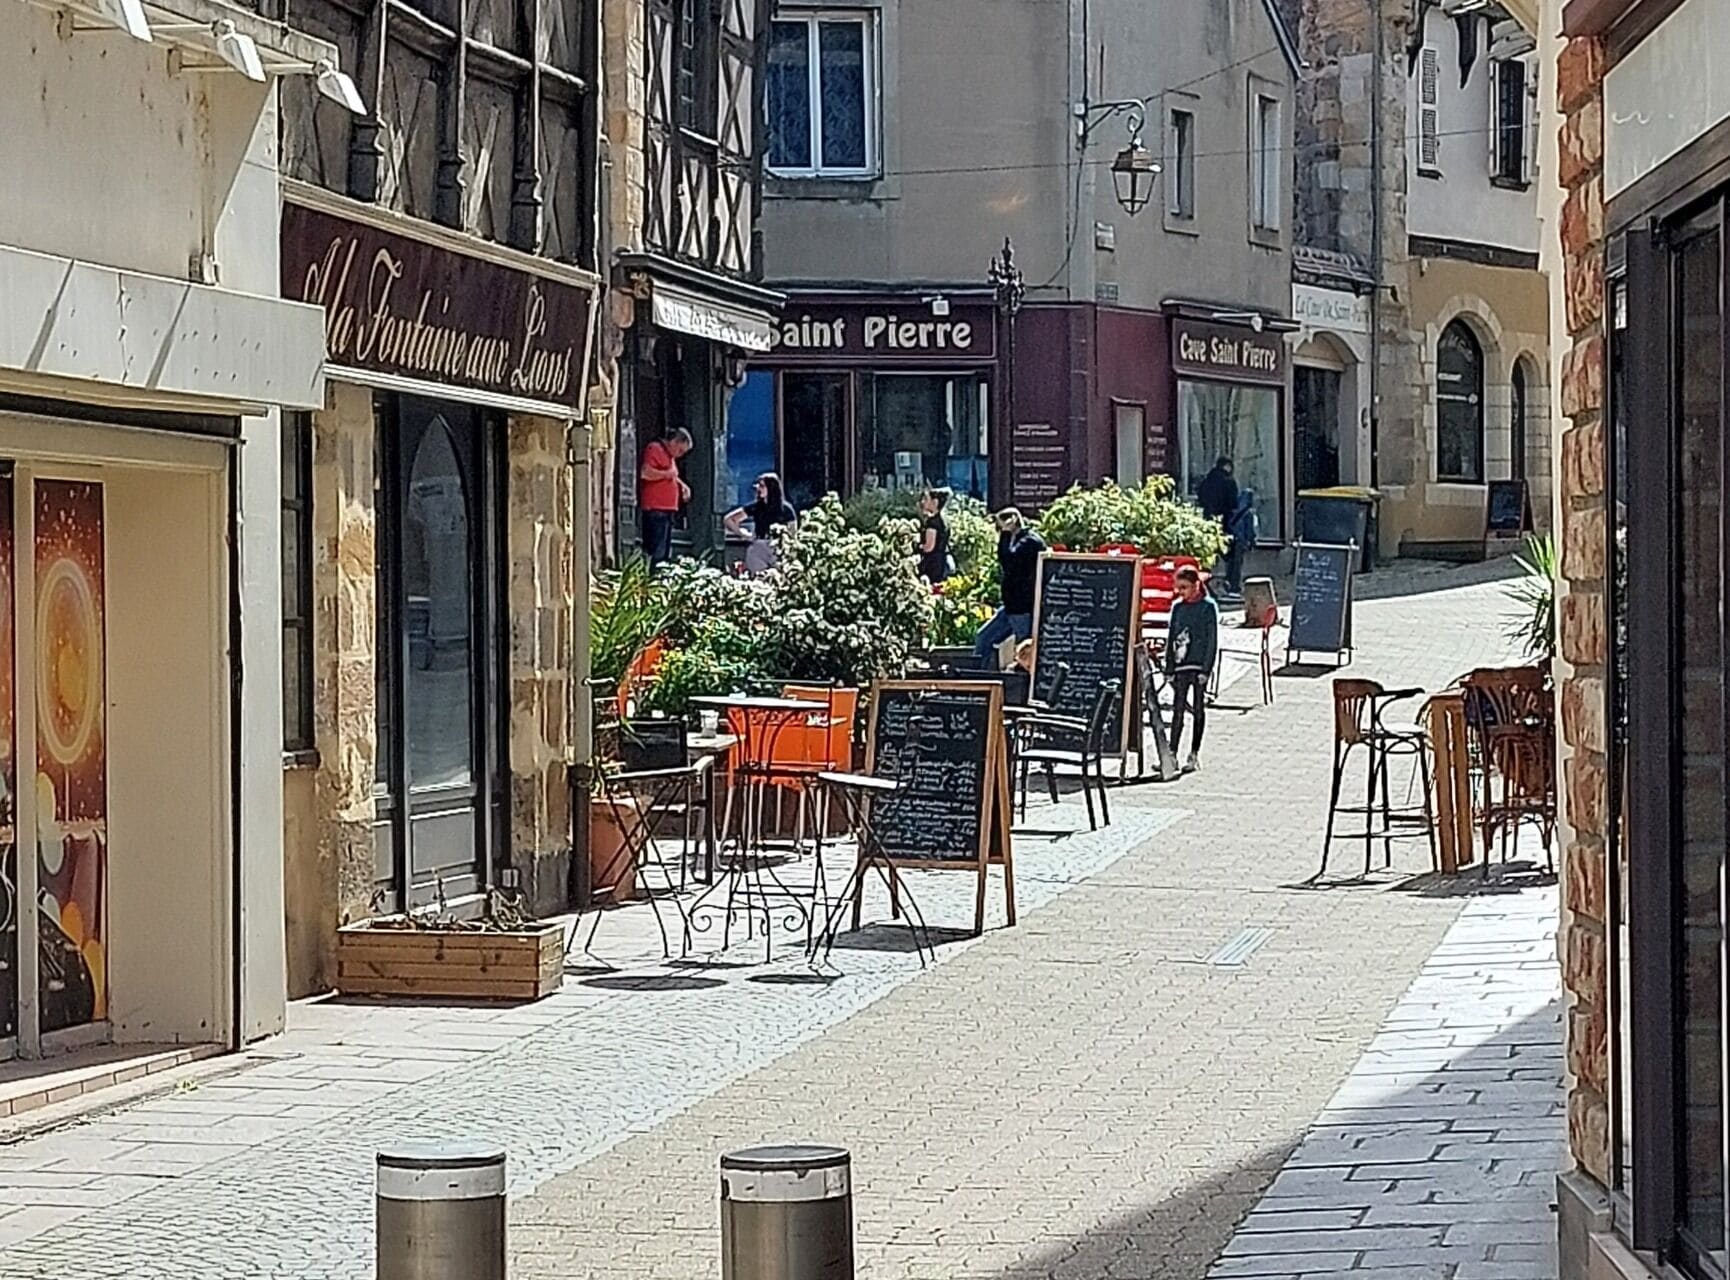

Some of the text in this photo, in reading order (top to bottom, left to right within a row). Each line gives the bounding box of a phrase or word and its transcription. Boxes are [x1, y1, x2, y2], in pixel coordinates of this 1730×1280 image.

[355, 247, 467, 377] Fontaine
[465, 334, 510, 384] aux
[510, 284, 572, 396] Lions
[864, 314, 972, 349] Pierre
[1180, 331, 1277, 372] Cave Saint Pierre
